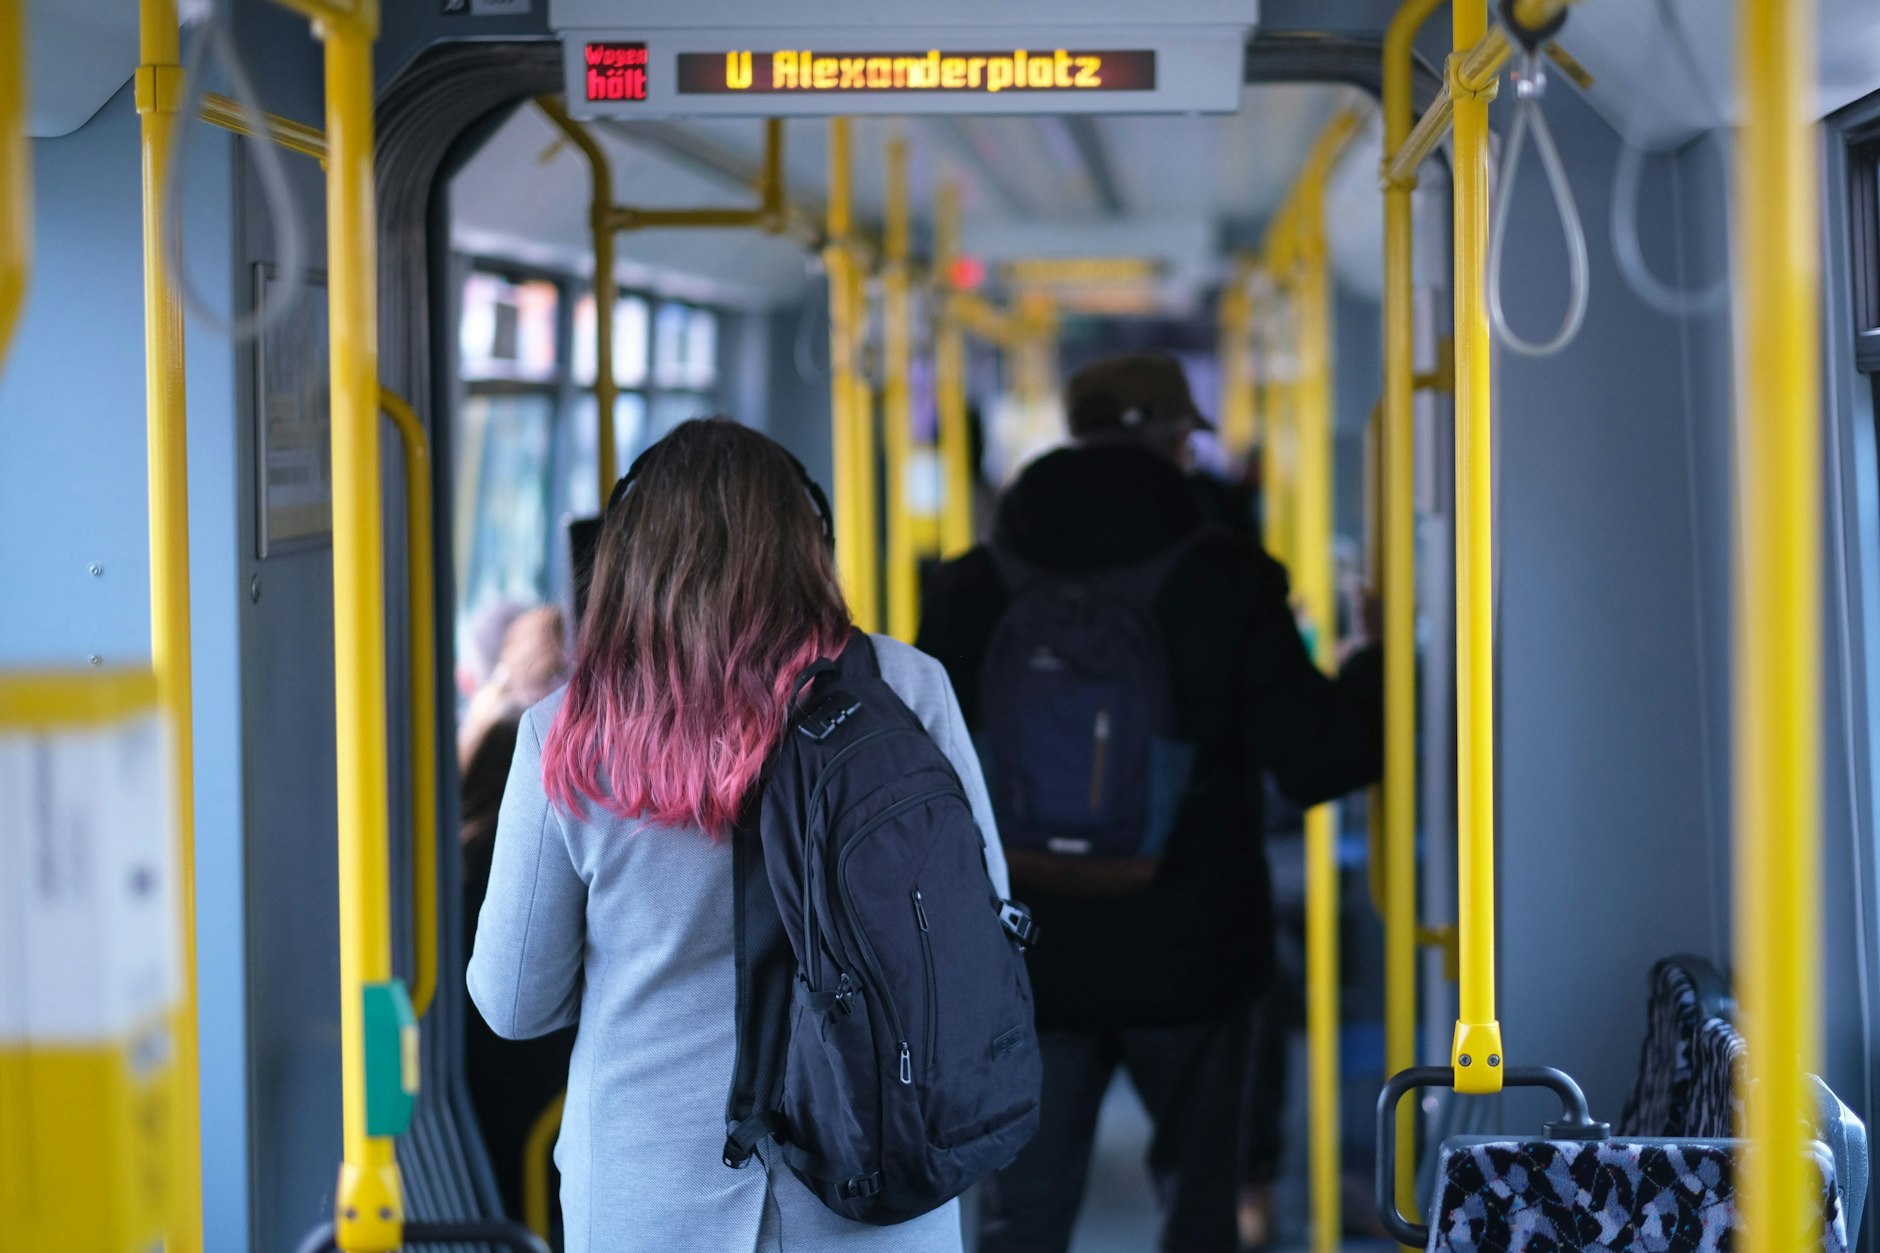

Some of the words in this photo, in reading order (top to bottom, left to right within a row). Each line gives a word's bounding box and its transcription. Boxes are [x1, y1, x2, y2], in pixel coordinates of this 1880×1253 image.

[585, 44, 648, 67] Wagen
[726, 50, 752, 89] U
[773, 49, 1102, 92] Alexanderplatz
[587, 69, 647, 100] hält
